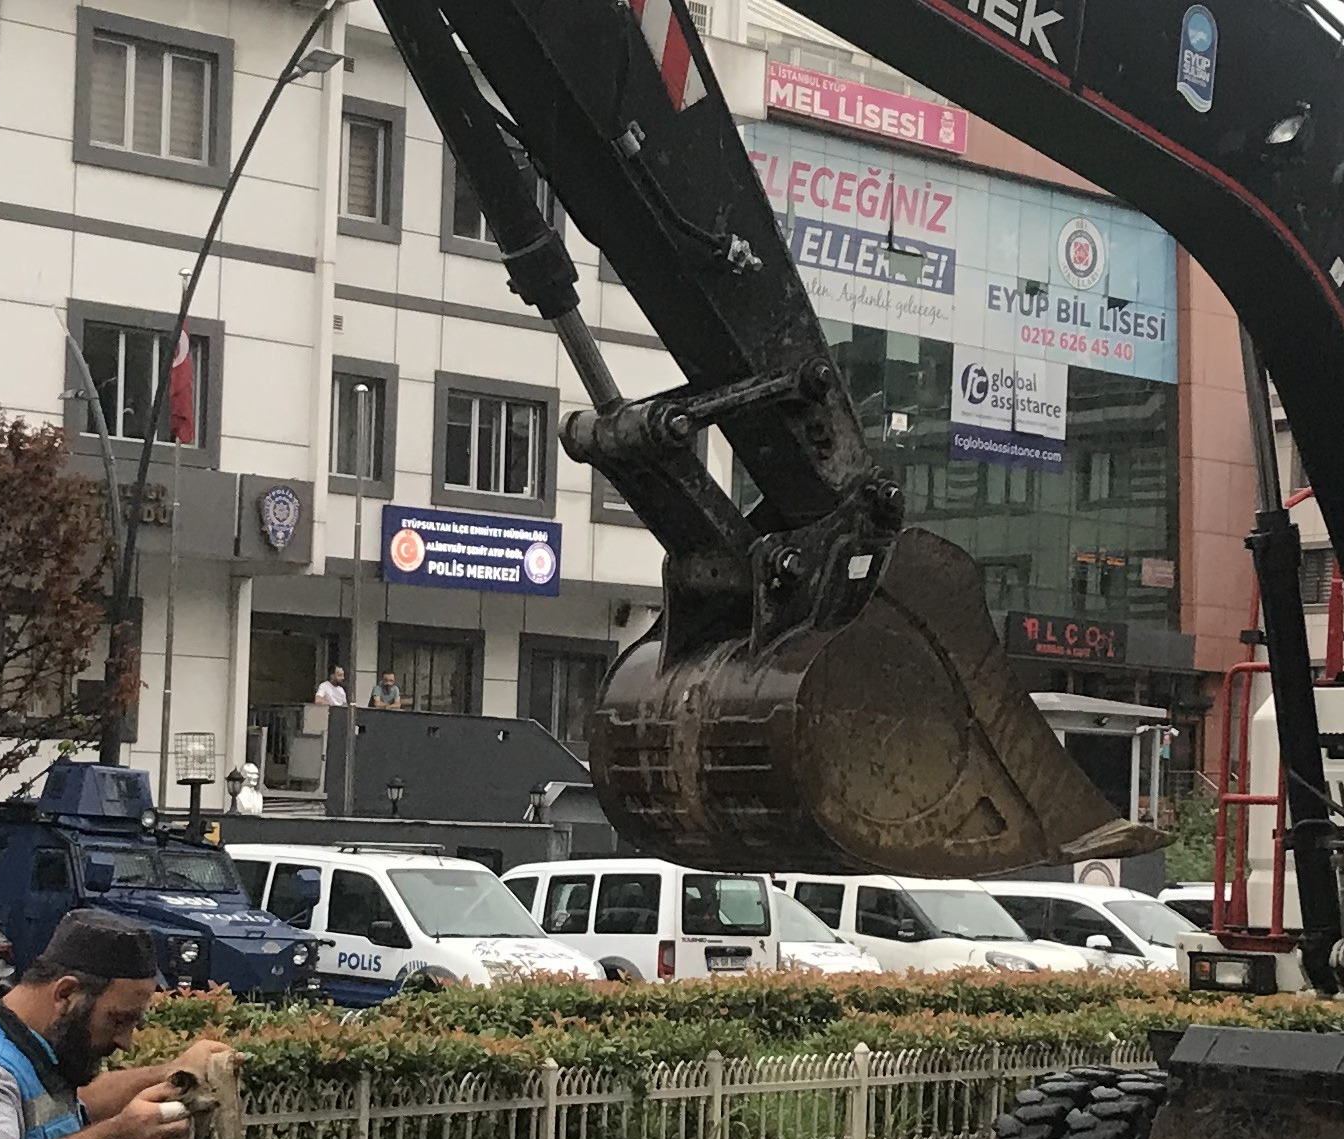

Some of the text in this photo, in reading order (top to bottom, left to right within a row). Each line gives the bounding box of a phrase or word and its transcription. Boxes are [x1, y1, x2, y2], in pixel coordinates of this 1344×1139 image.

[838, 95, 925, 140] LİSESİ
[1056, 295, 1092, 328] BİL
[1021, 324, 1134, 361] 0212 626 45 40
[991, 368, 1038, 393] global
[954, 434, 1062, 462] fcglobalassistance.com
[401, 518, 452, 533] EYÜPSULTAN
[452, 521, 469, 535] İLÇE
[428, 558, 521, 582] POLİS MERKEZİ
[338, 951, 382, 973] POLİS
